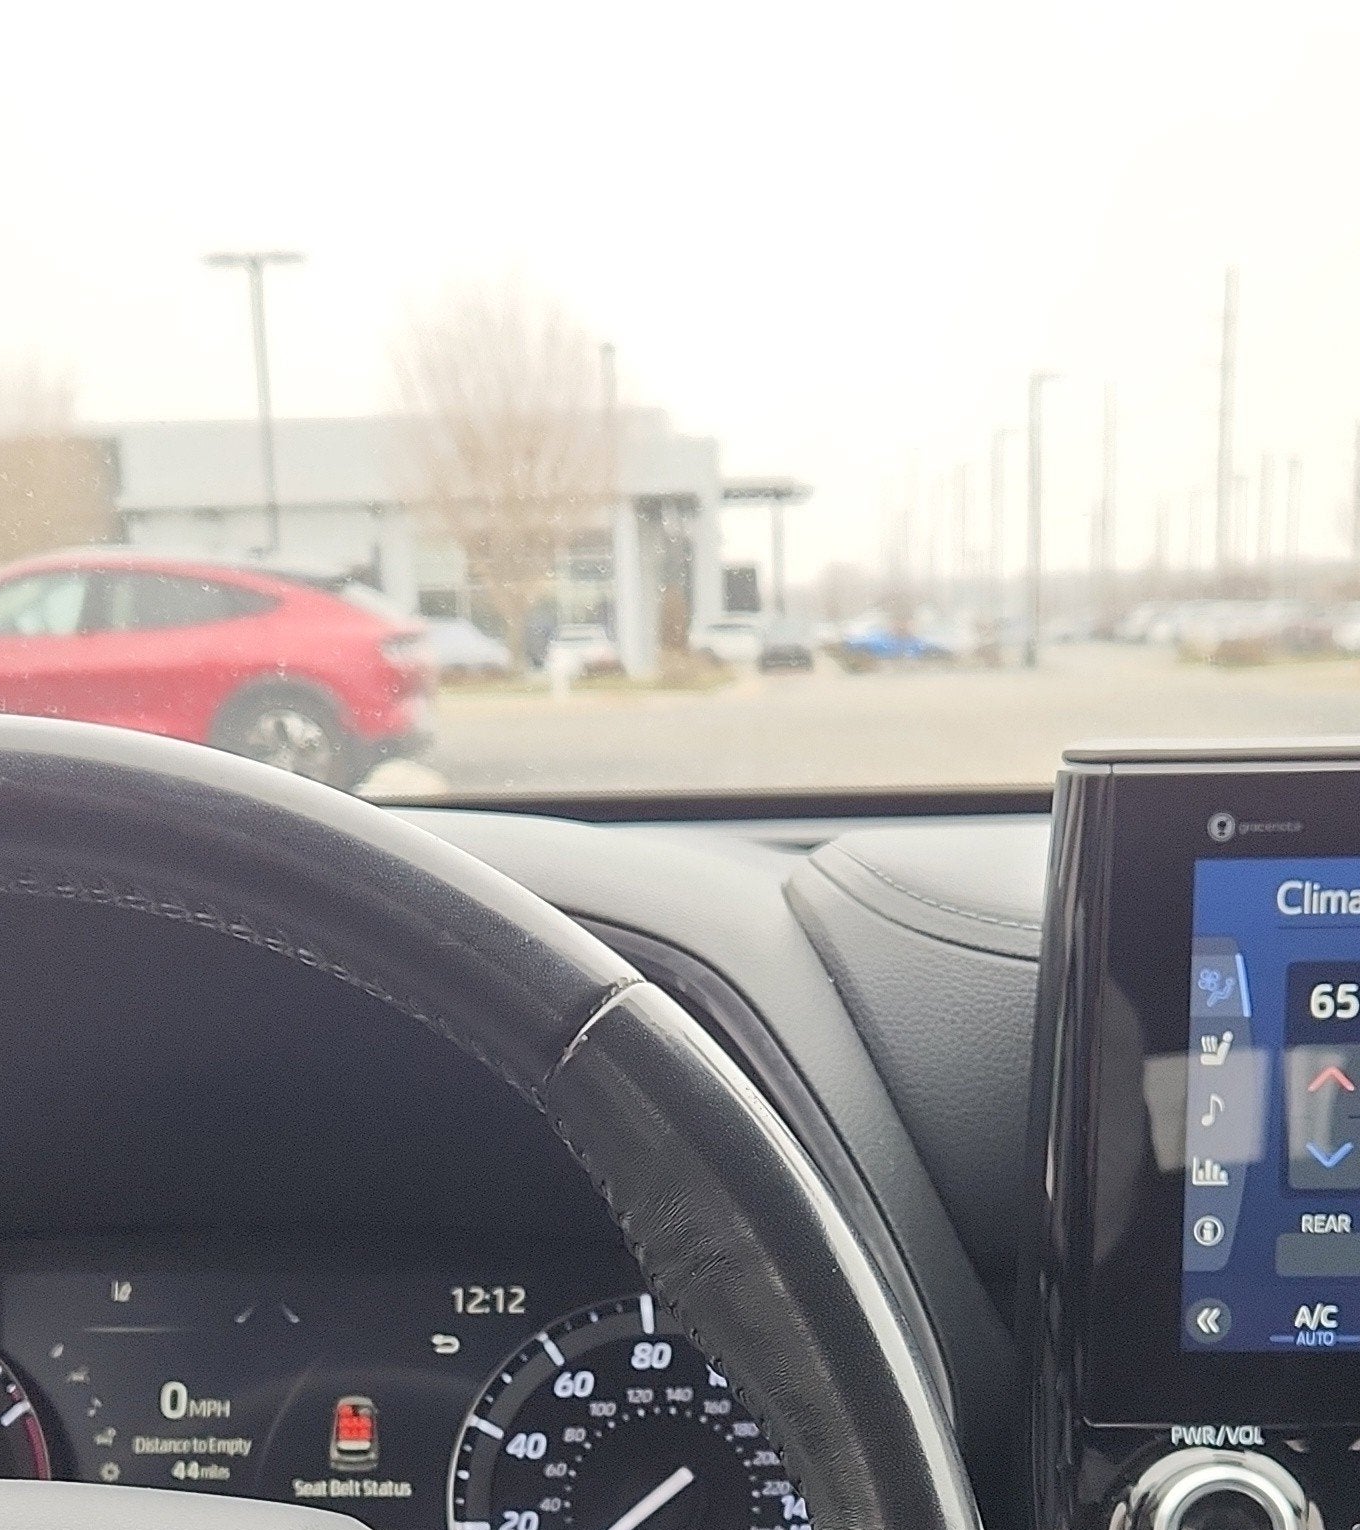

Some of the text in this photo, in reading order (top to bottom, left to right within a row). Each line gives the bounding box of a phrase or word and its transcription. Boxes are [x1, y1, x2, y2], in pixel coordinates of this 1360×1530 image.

[1309, 983, 1360, 1019] 65
[1301, 1214, 1352, 1233] REAR
[451, 1286, 526, 1314] 12:12
[1294, 1303, 1339, 1329] A/C
[1296, 1331, 1334, 1346] AUTO
[630, 1342, 672, 1370] 80
[553, 1370, 595, 1398] 60
[160, 1380, 230, 1420] 0 MPH
[666, 1387, 693, 1402] 140
[590, 1402, 617, 1417] 100
[505, 1431, 547, 1459] 40
[564, 1427, 586, 1443] 80
[1171, 1425, 1265, 1446] PWR/VOL
[134, 1437, 251, 1456] Distance to Empty
[172, 1460, 200, 1480] 44
[544, 1462, 567, 1477] 60
[294, 1480, 411, 1498] Seat Belt Status
[540, 1498, 561, 1512] 40
[781, 1494, 808, 1521] 14
